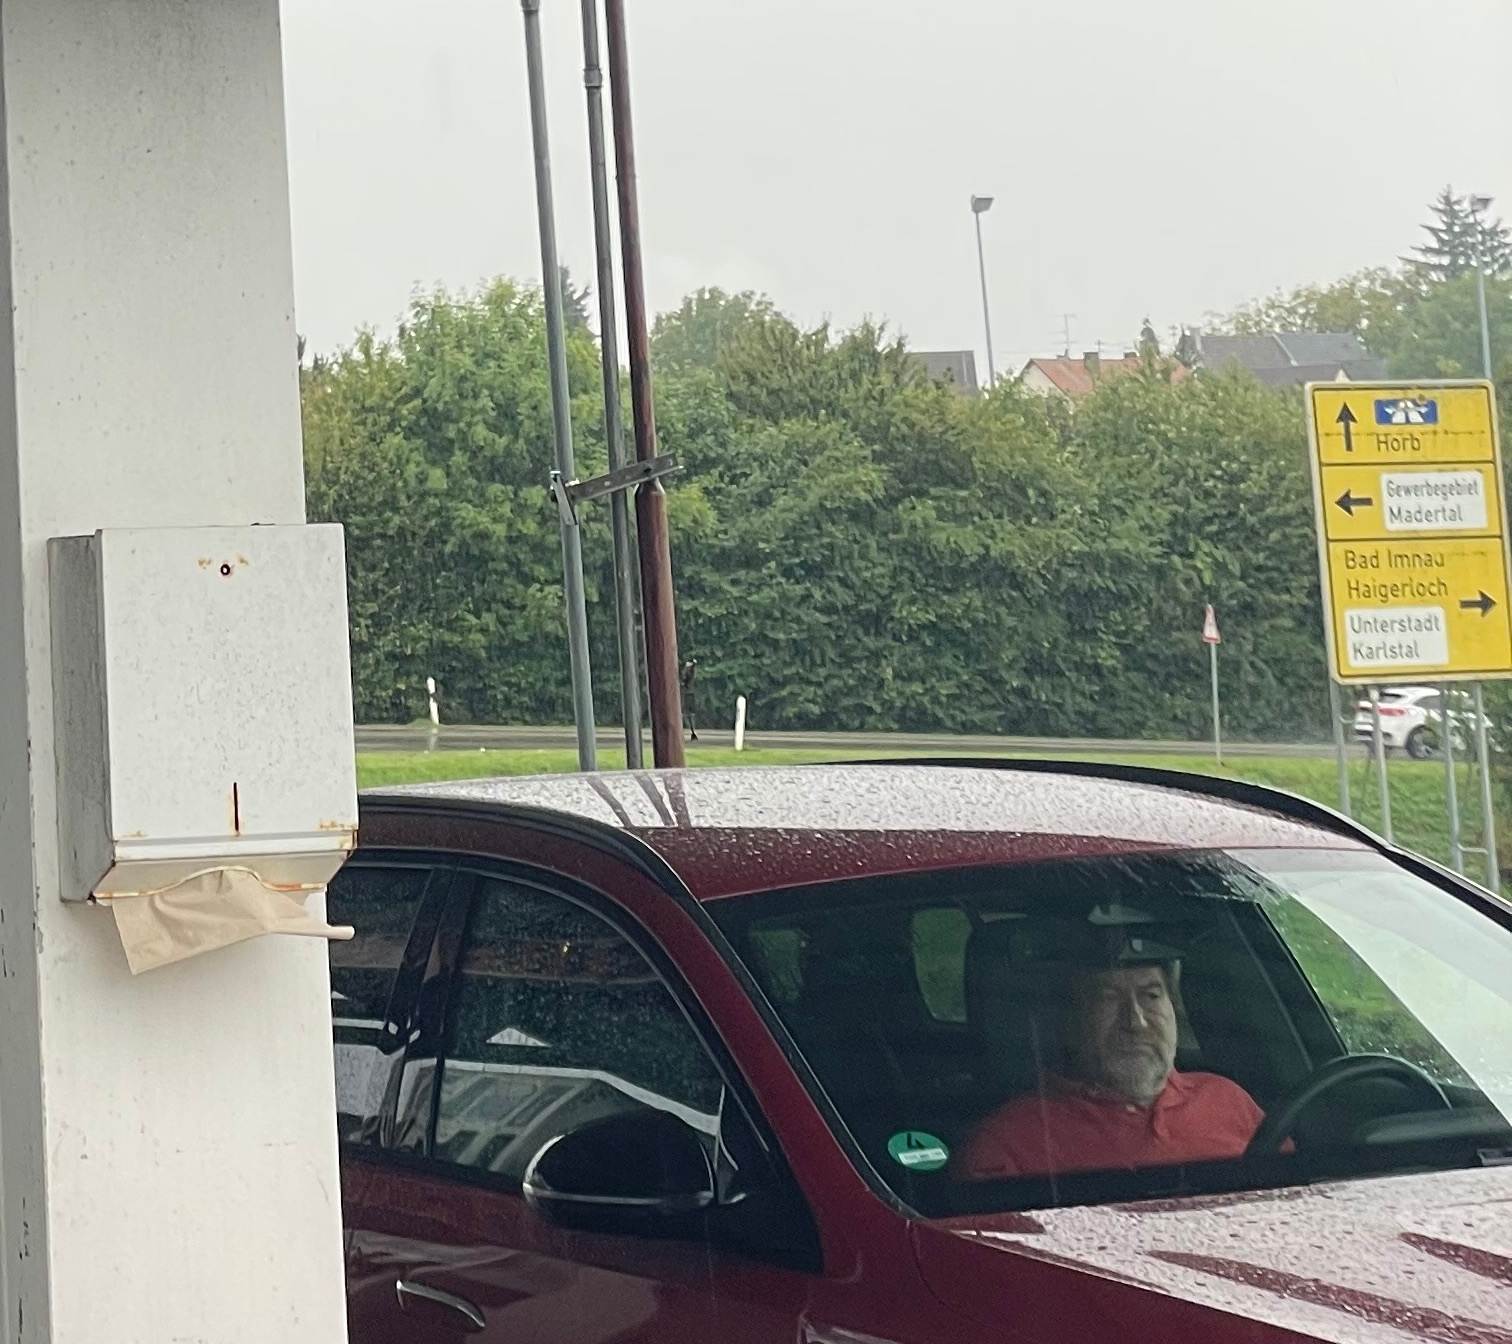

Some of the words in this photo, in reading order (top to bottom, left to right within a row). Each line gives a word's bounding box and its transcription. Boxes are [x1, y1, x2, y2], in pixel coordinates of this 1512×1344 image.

[1376, 433, 1421, 453] Horb
[1387, 478, 1478, 501] Gewerbegebiet
[1389, 505, 1464, 523] Madertal
[1344, 550, 1380, 570] Bad
[1388, 549, 1445, 569] Imnau
[1348, 577, 1448, 603] Haigerloch
[1350, 615, 1440, 635] Unterstadt
[1353, 640, 1420, 660] Karlstal
